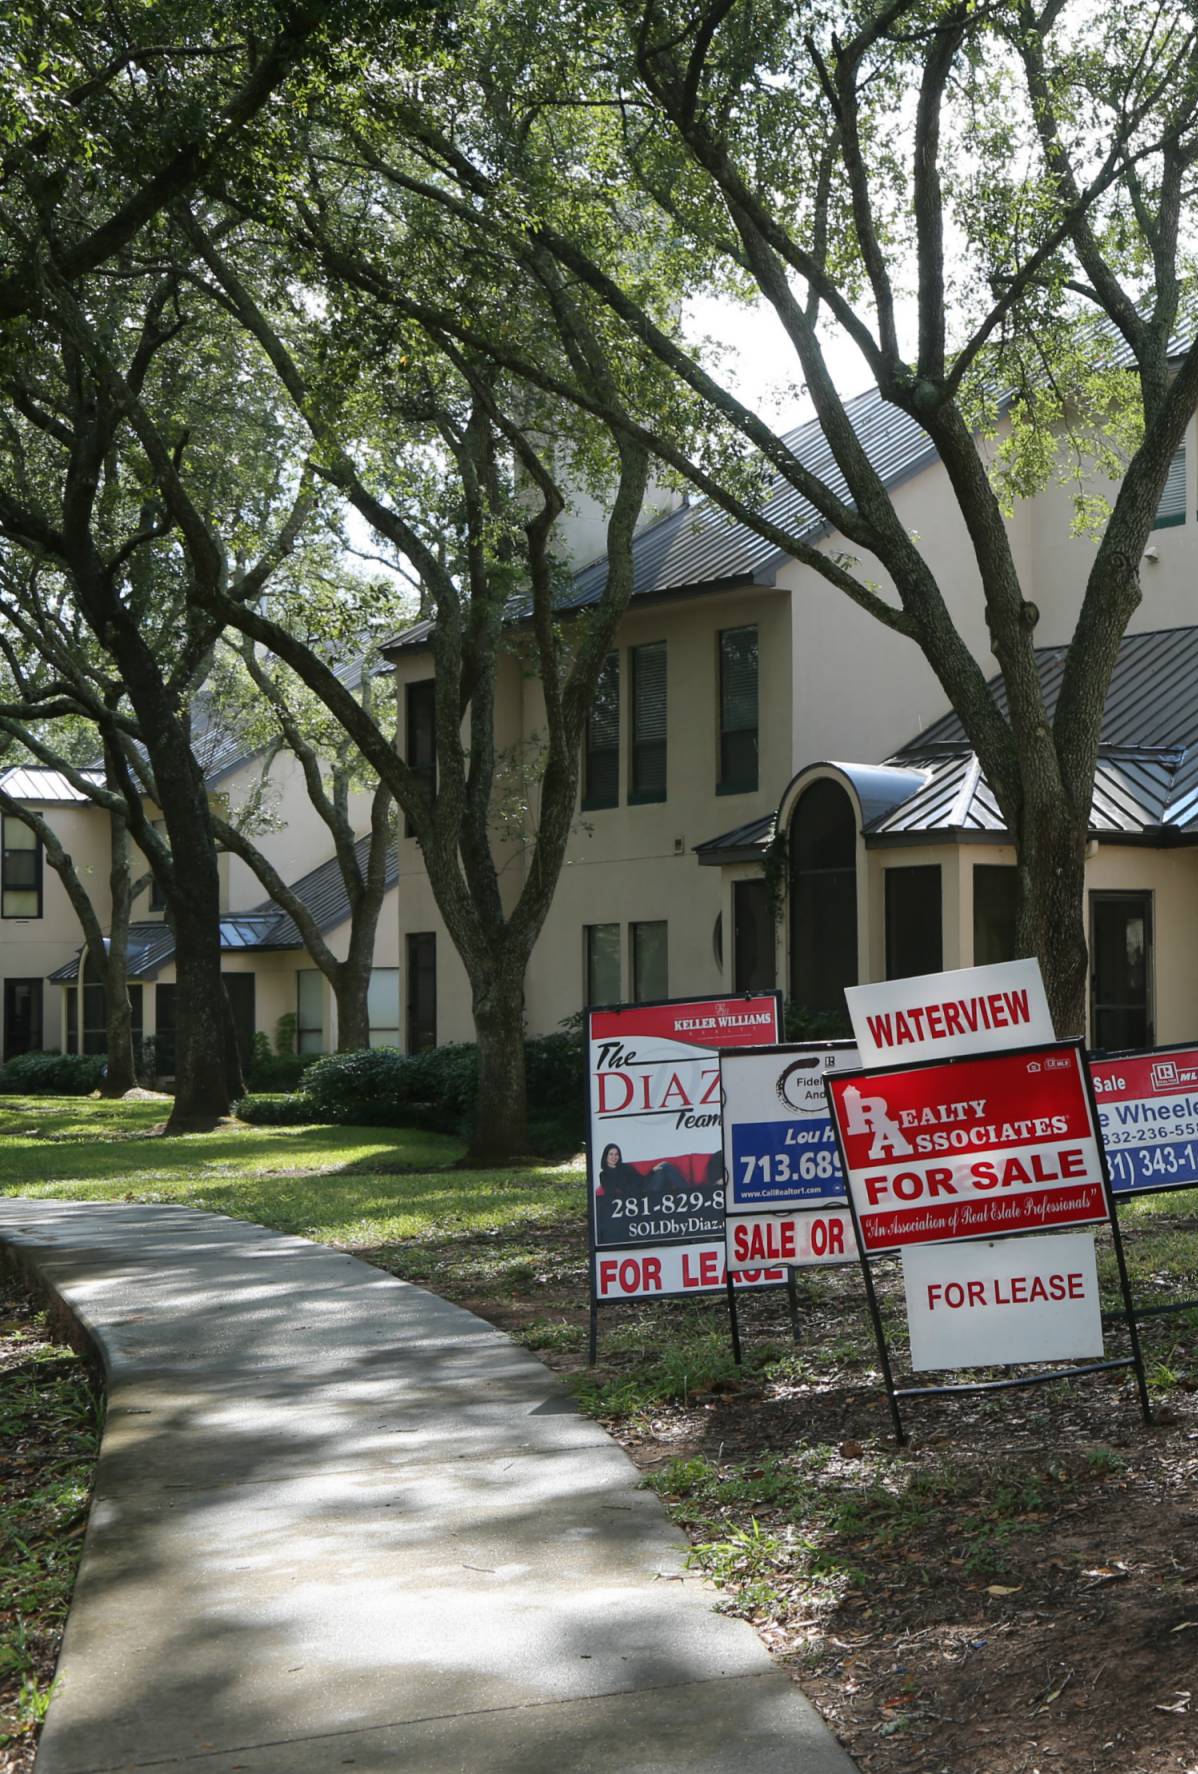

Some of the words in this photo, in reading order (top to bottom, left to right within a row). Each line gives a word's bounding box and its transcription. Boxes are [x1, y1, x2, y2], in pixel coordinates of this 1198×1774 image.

[674, 1018, 717, 1032] KELLER
[718, 1013, 771, 1028] WILLIAMS
[866, 989, 1031, 1049] WATERVIEW
[597, 1042, 637, 1070] The
[593, 1070, 721, 1113] DIAZ
[1093, 1075, 1126, 1093] Sale
[676, 1108, 722, 1130] Team
[842, 1086, 987, 1136] REALTY
[784, 1128, 821, 1145] Lou
[868, 1116, 1069, 1160] ASSOCIATES
[864, 1167, 958, 1205] FOR
[970, 1148, 1088, 1190] SALE
[887, 1214, 945, 1236] Association
[948, 1208, 959, 1234] of
[961, 1204, 989, 1226] Real
[991, 1201, 1022, 1222] Estate
[734, 1220, 796, 1262] SALE
[811, 1218, 844, 1256] OR
[600, 1257, 662, 1295] FOR
[927, 1280, 987, 1311] FOR
[994, 1272, 1085, 1304] LEASE
